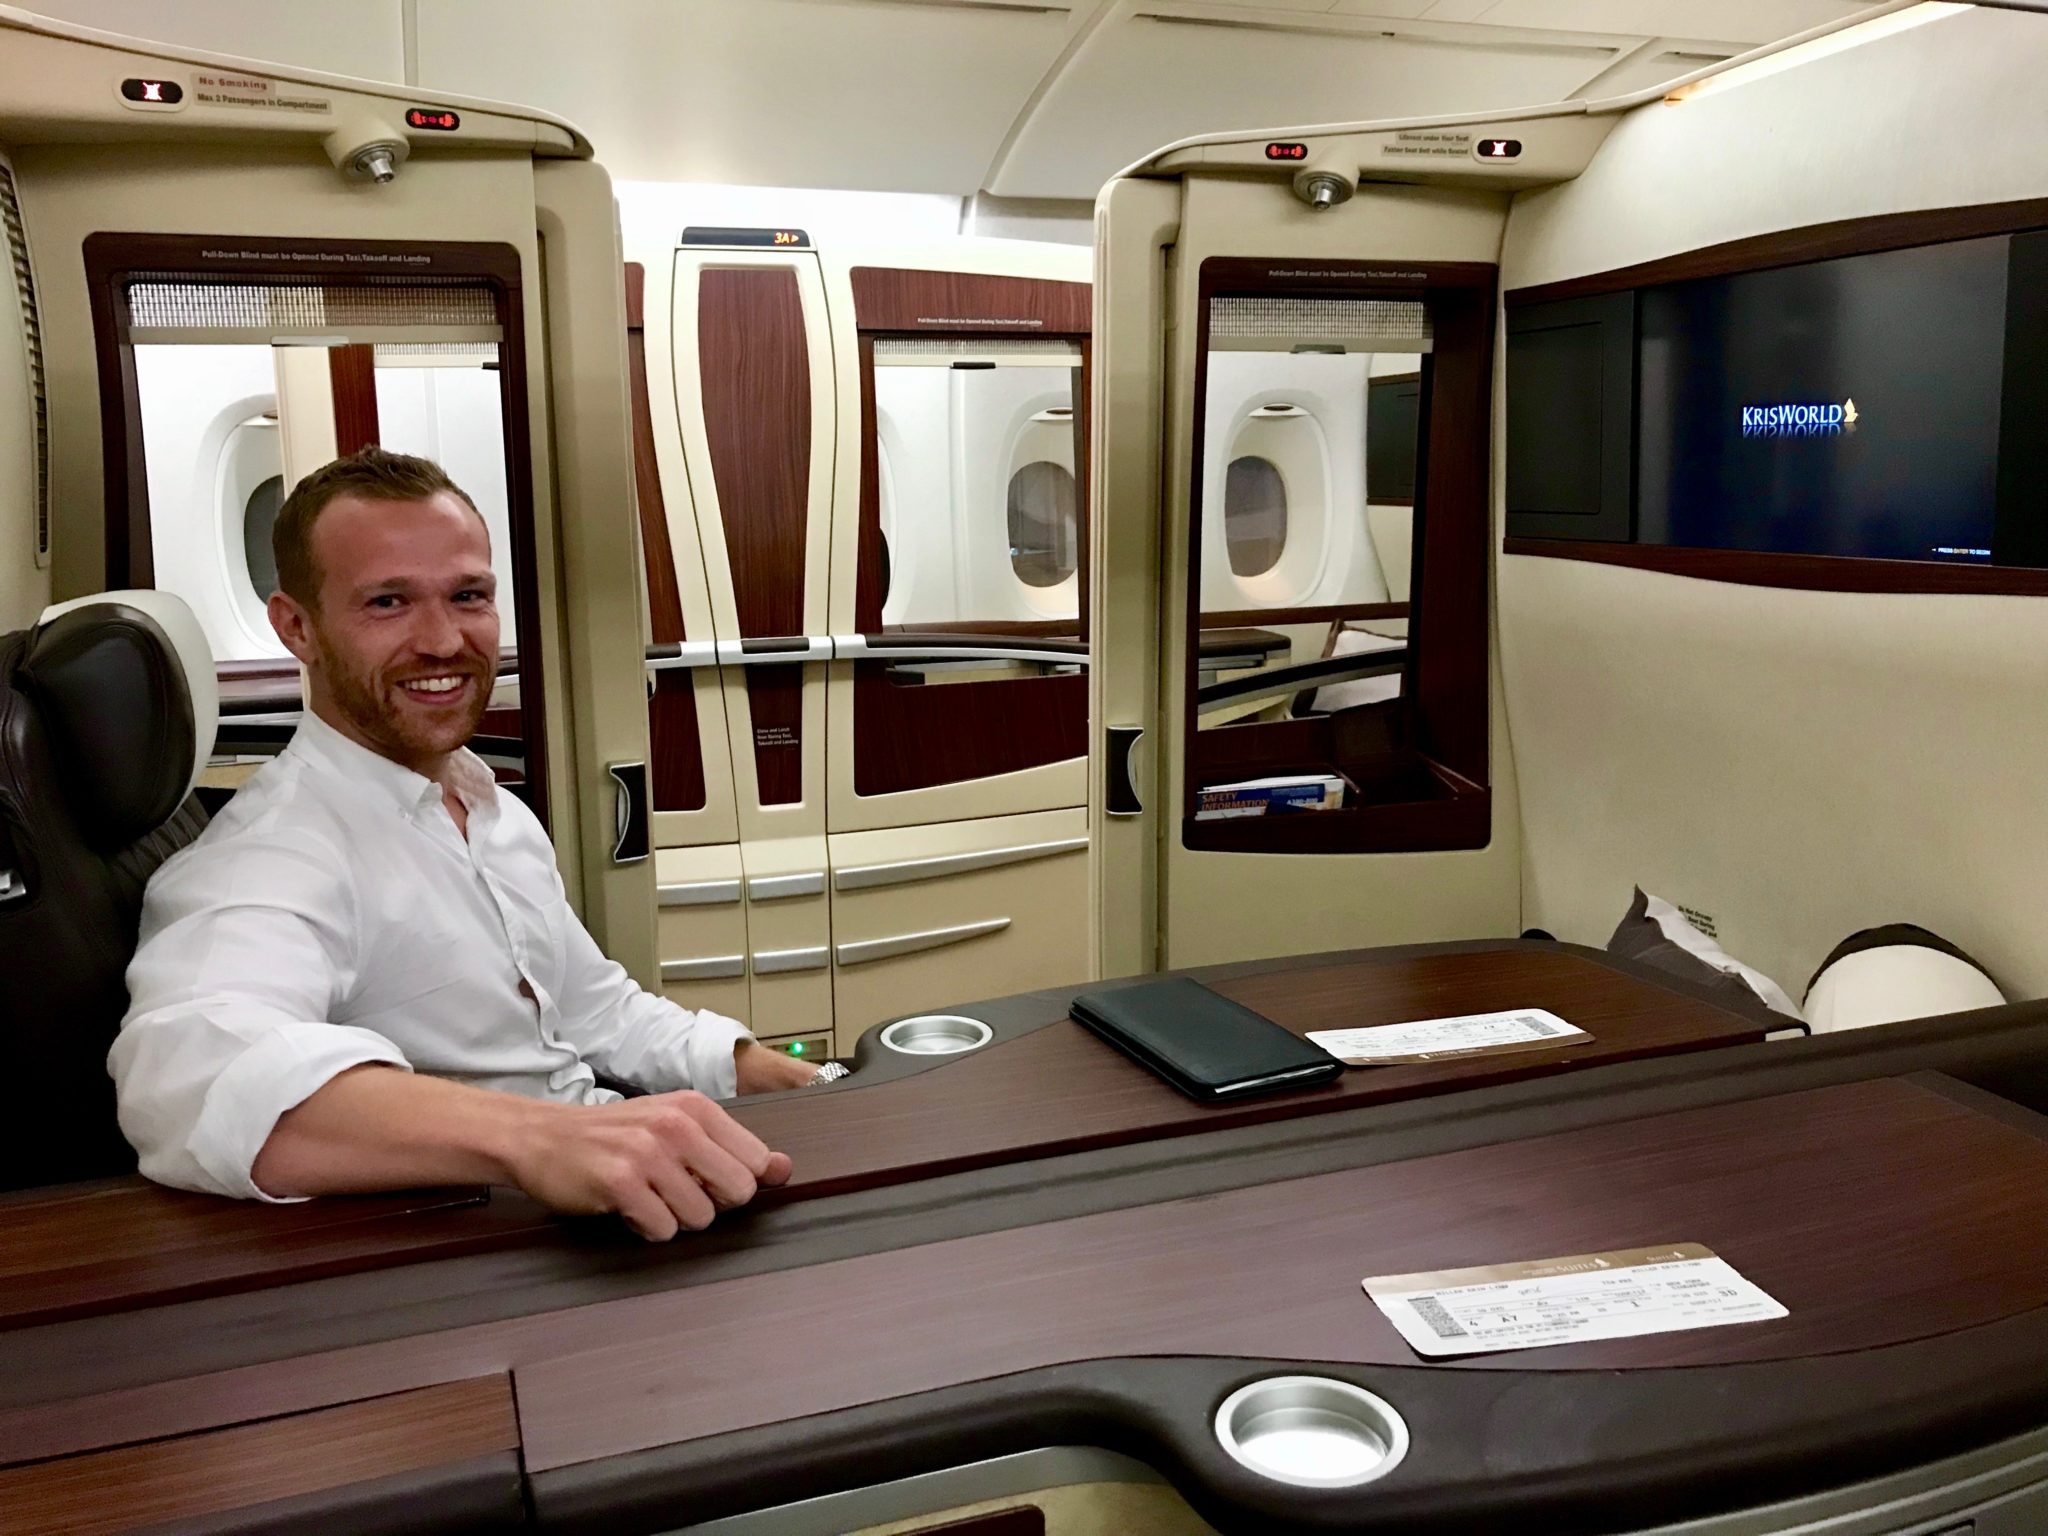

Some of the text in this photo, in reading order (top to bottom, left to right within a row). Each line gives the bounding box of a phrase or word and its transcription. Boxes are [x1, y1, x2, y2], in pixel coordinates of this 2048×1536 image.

[199, 77, 268, 91] No Smoking
[223, 95, 267, 107] Passengers
[277, 98, 328, 111] Compartment
[774, 232, 790, 244] 3A
[240, 251, 260, 260] Blind
[261, 252, 279, 260] must
[280, 252, 291, 260] be
[291, 252, 319, 262] Opened
[320, 253, 344, 262] During
[388, 254, 402, 262] and
[403, 254, 431, 264] Landing
[1743, 404, 1842, 426] KRISWORLD
[1202, 791, 1239, 802] SAFETY
[1201, 799, 1270, 812] INFORMATION
